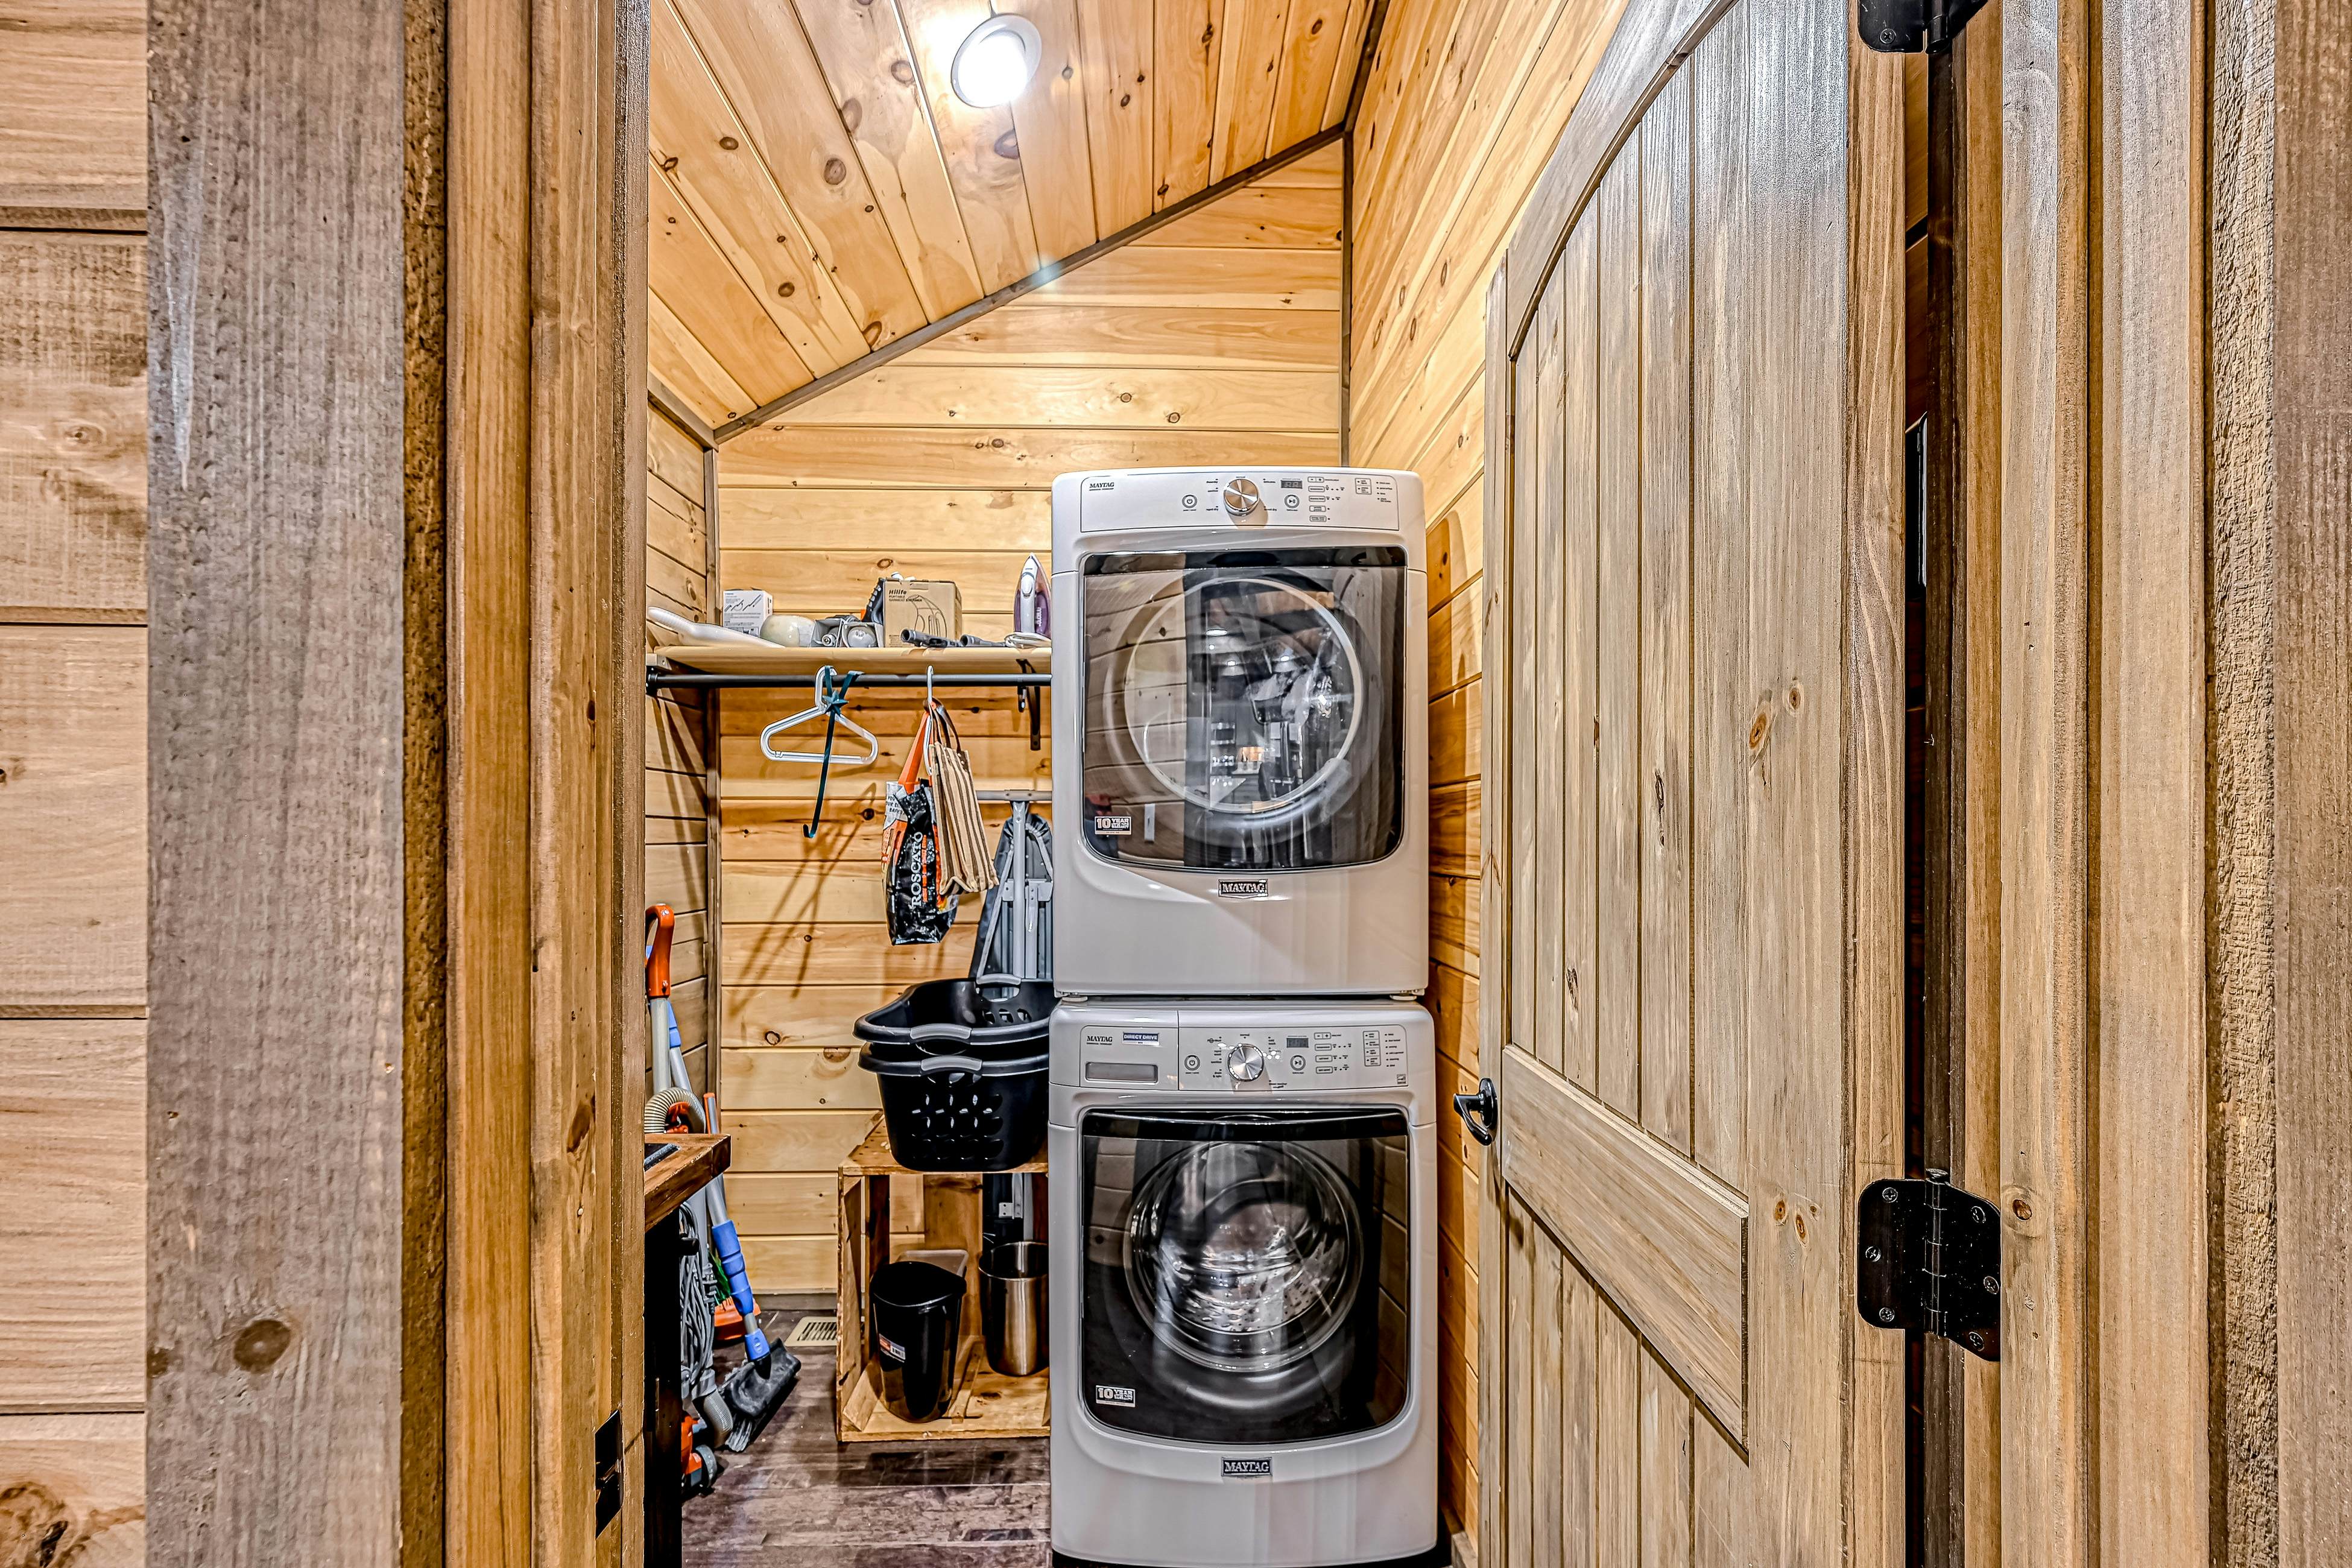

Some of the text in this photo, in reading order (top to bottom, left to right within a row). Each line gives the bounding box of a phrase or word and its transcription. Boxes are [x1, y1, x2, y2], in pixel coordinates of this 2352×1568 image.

[1096, 818, 1111, 829] 10
[1222, 883, 1265, 893] MAYTAG
[1098, 1387, 1114, 1399] 10
[1224, 1461, 1269, 1473] MAYTAG
